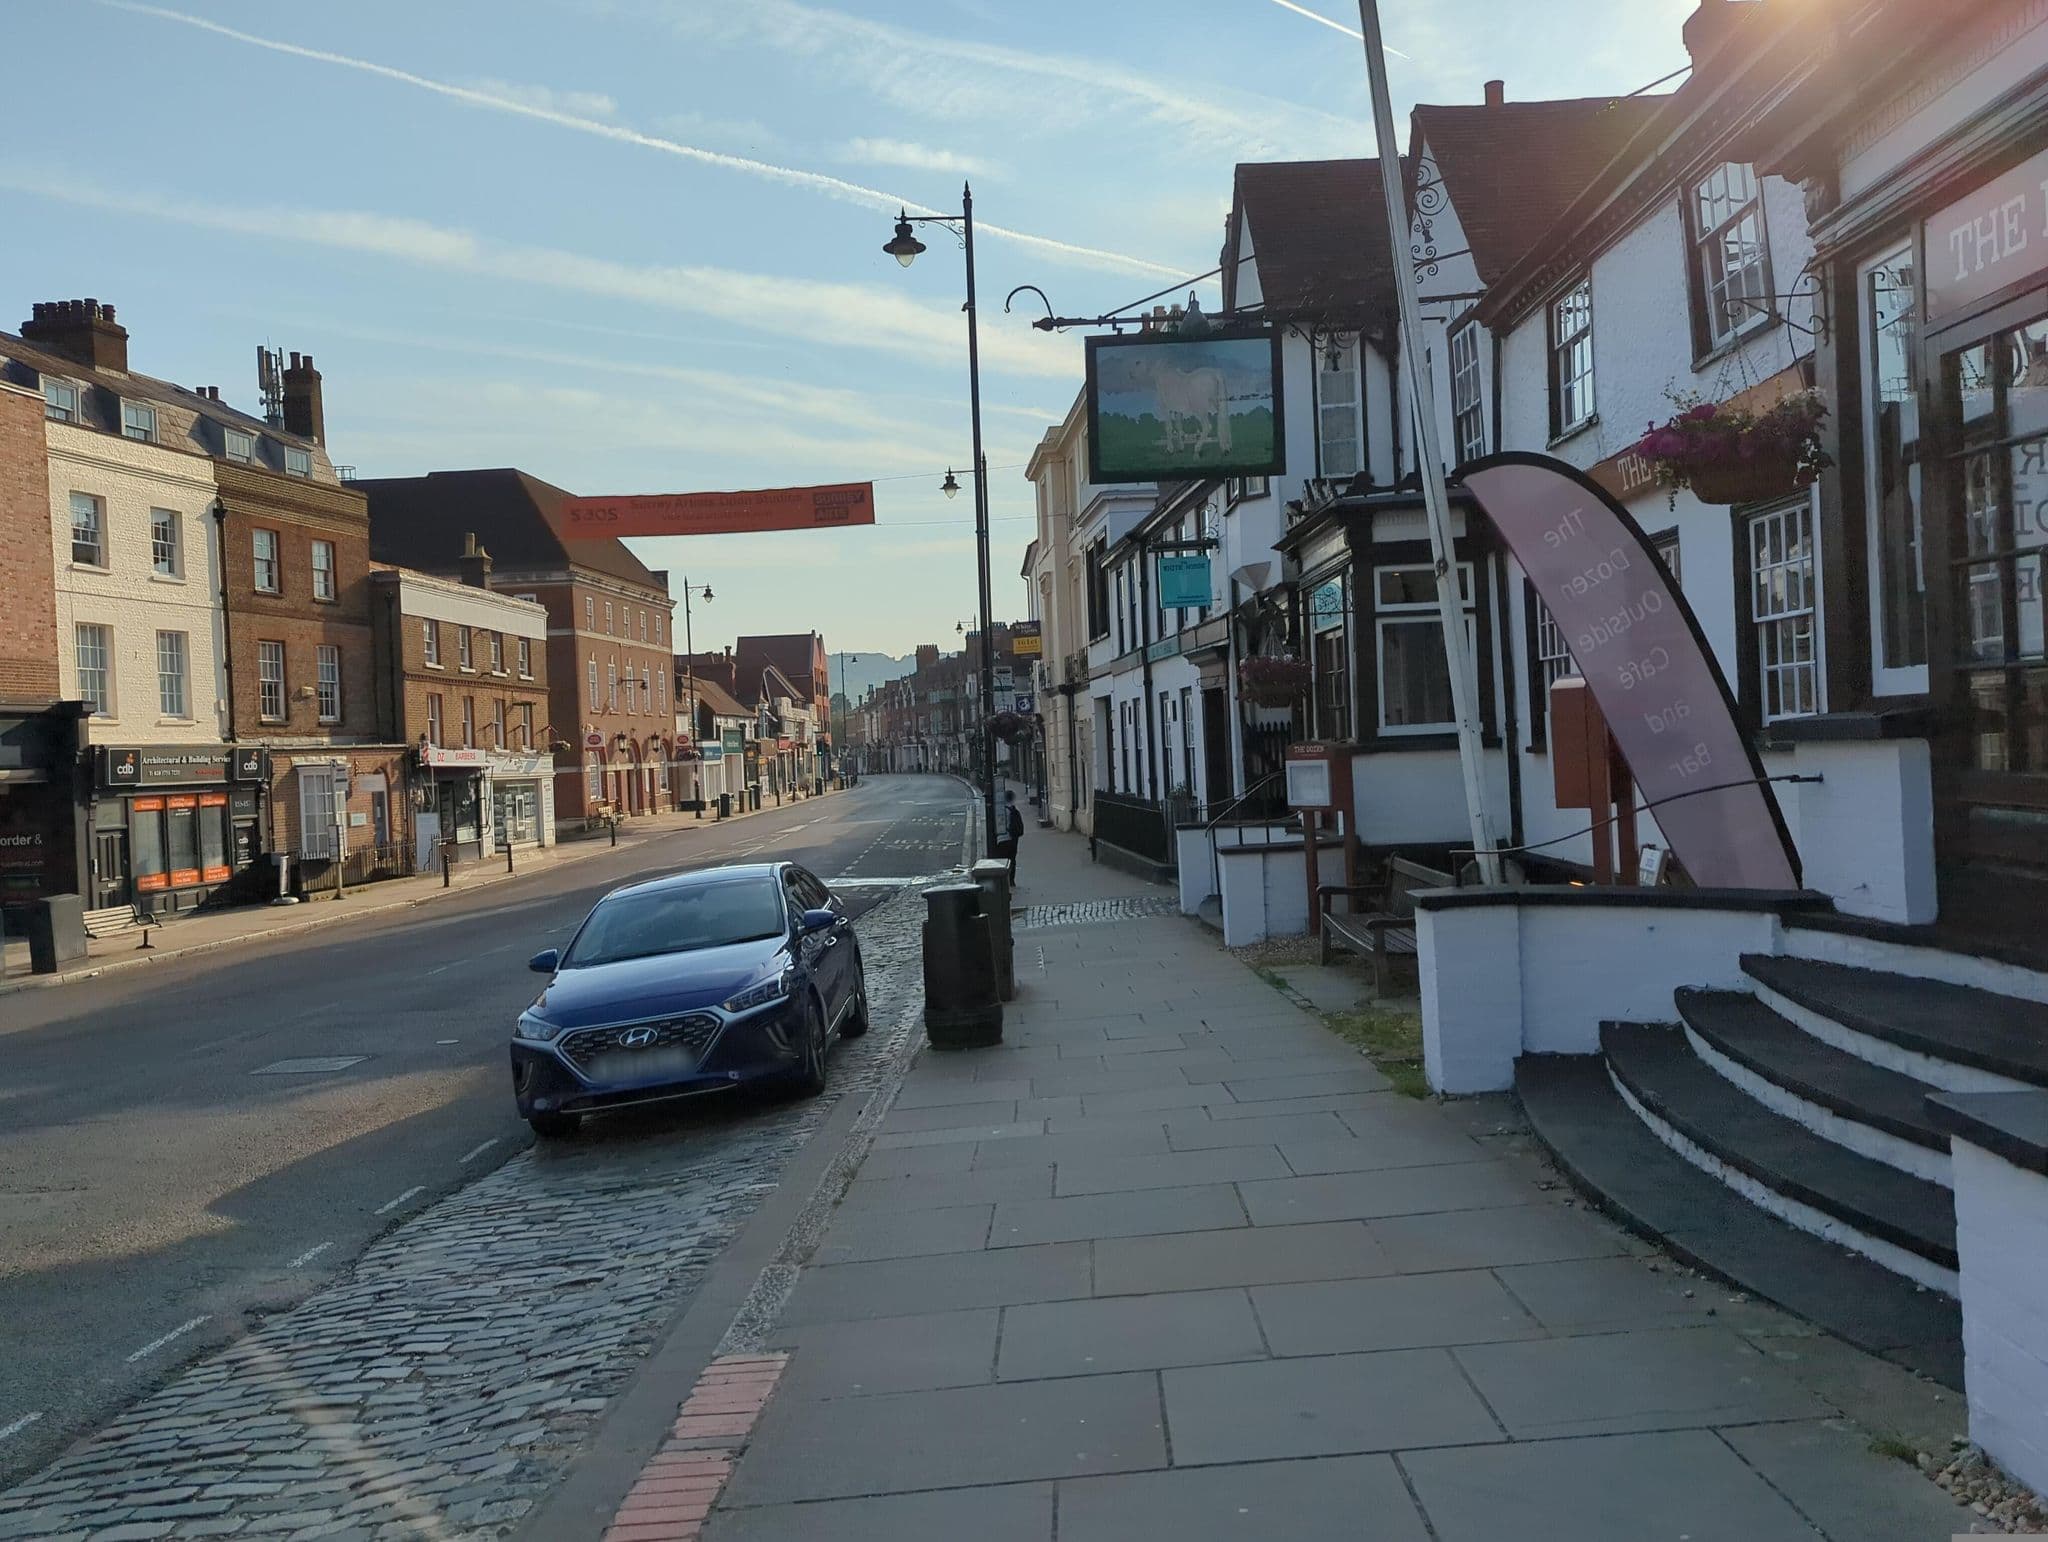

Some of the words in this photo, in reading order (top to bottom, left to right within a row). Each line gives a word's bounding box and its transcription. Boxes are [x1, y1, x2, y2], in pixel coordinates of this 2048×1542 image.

[1949, 193, 2027, 281] THE
[1617, 453, 1652, 492] THE
[116, 763, 134, 775] cdb
[243, 760, 258, 771] cdb
[0, 834, 32, 846] order
[35, 833, 42, 845] &
